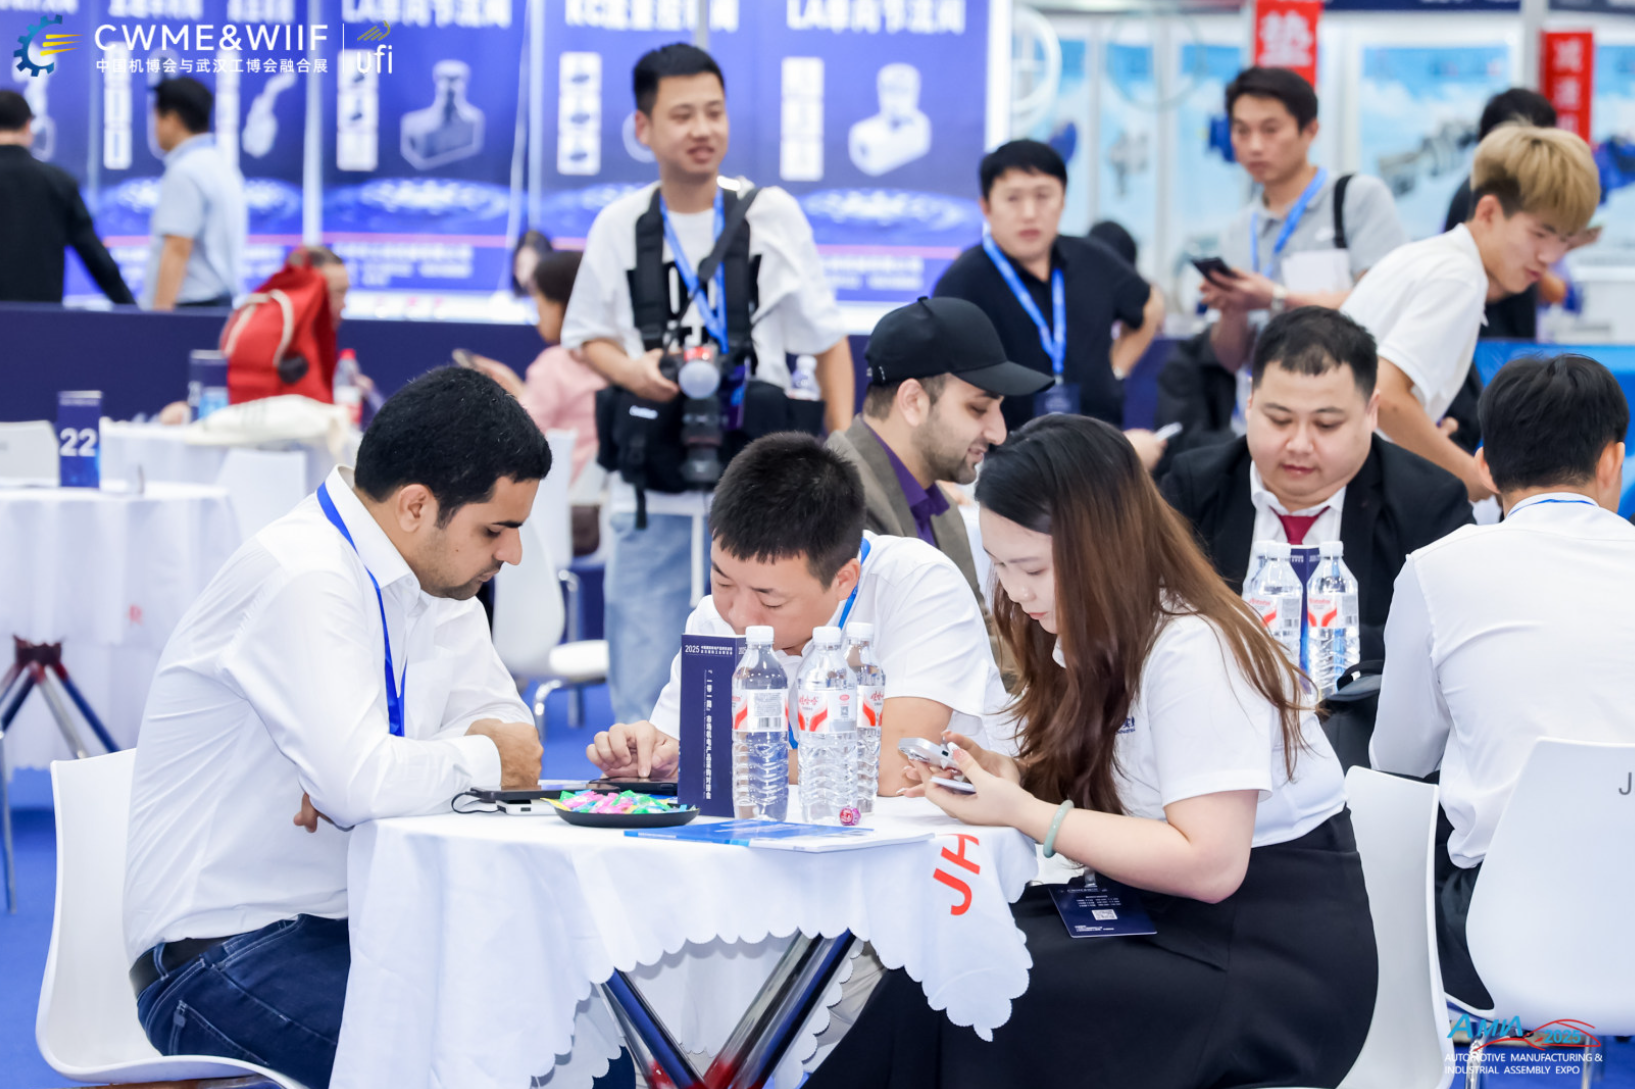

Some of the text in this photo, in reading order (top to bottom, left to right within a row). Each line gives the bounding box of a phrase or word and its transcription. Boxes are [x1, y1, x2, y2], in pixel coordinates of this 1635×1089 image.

[60, 427, 97, 457] 22
[684, 644, 700, 654] 2025
[1618, 771, 1632, 796] J
